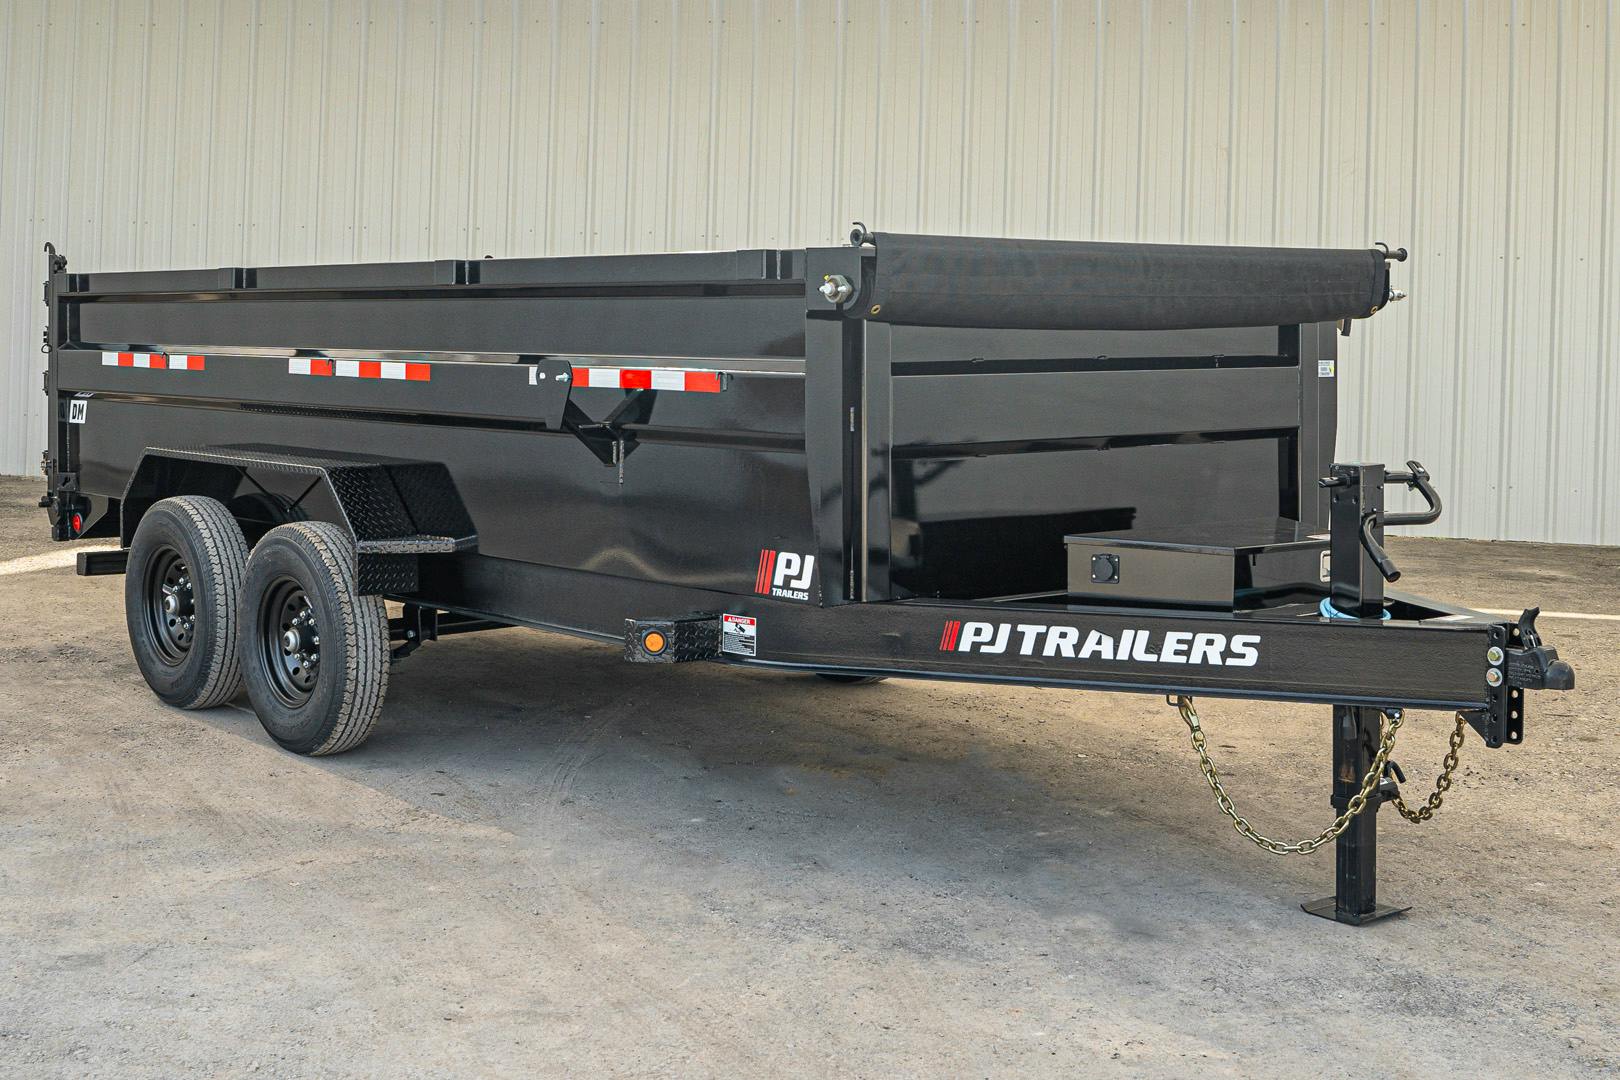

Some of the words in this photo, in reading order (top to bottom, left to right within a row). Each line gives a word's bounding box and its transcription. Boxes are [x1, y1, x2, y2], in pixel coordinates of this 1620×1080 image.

[72, 403, 85, 420] DM
[773, 551, 815, 590] PJ
[772, 588, 809, 601] TRAILERS
[958, 621, 1012, 654] PJ
[1016, 623, 1262, 667] TRAILERS
